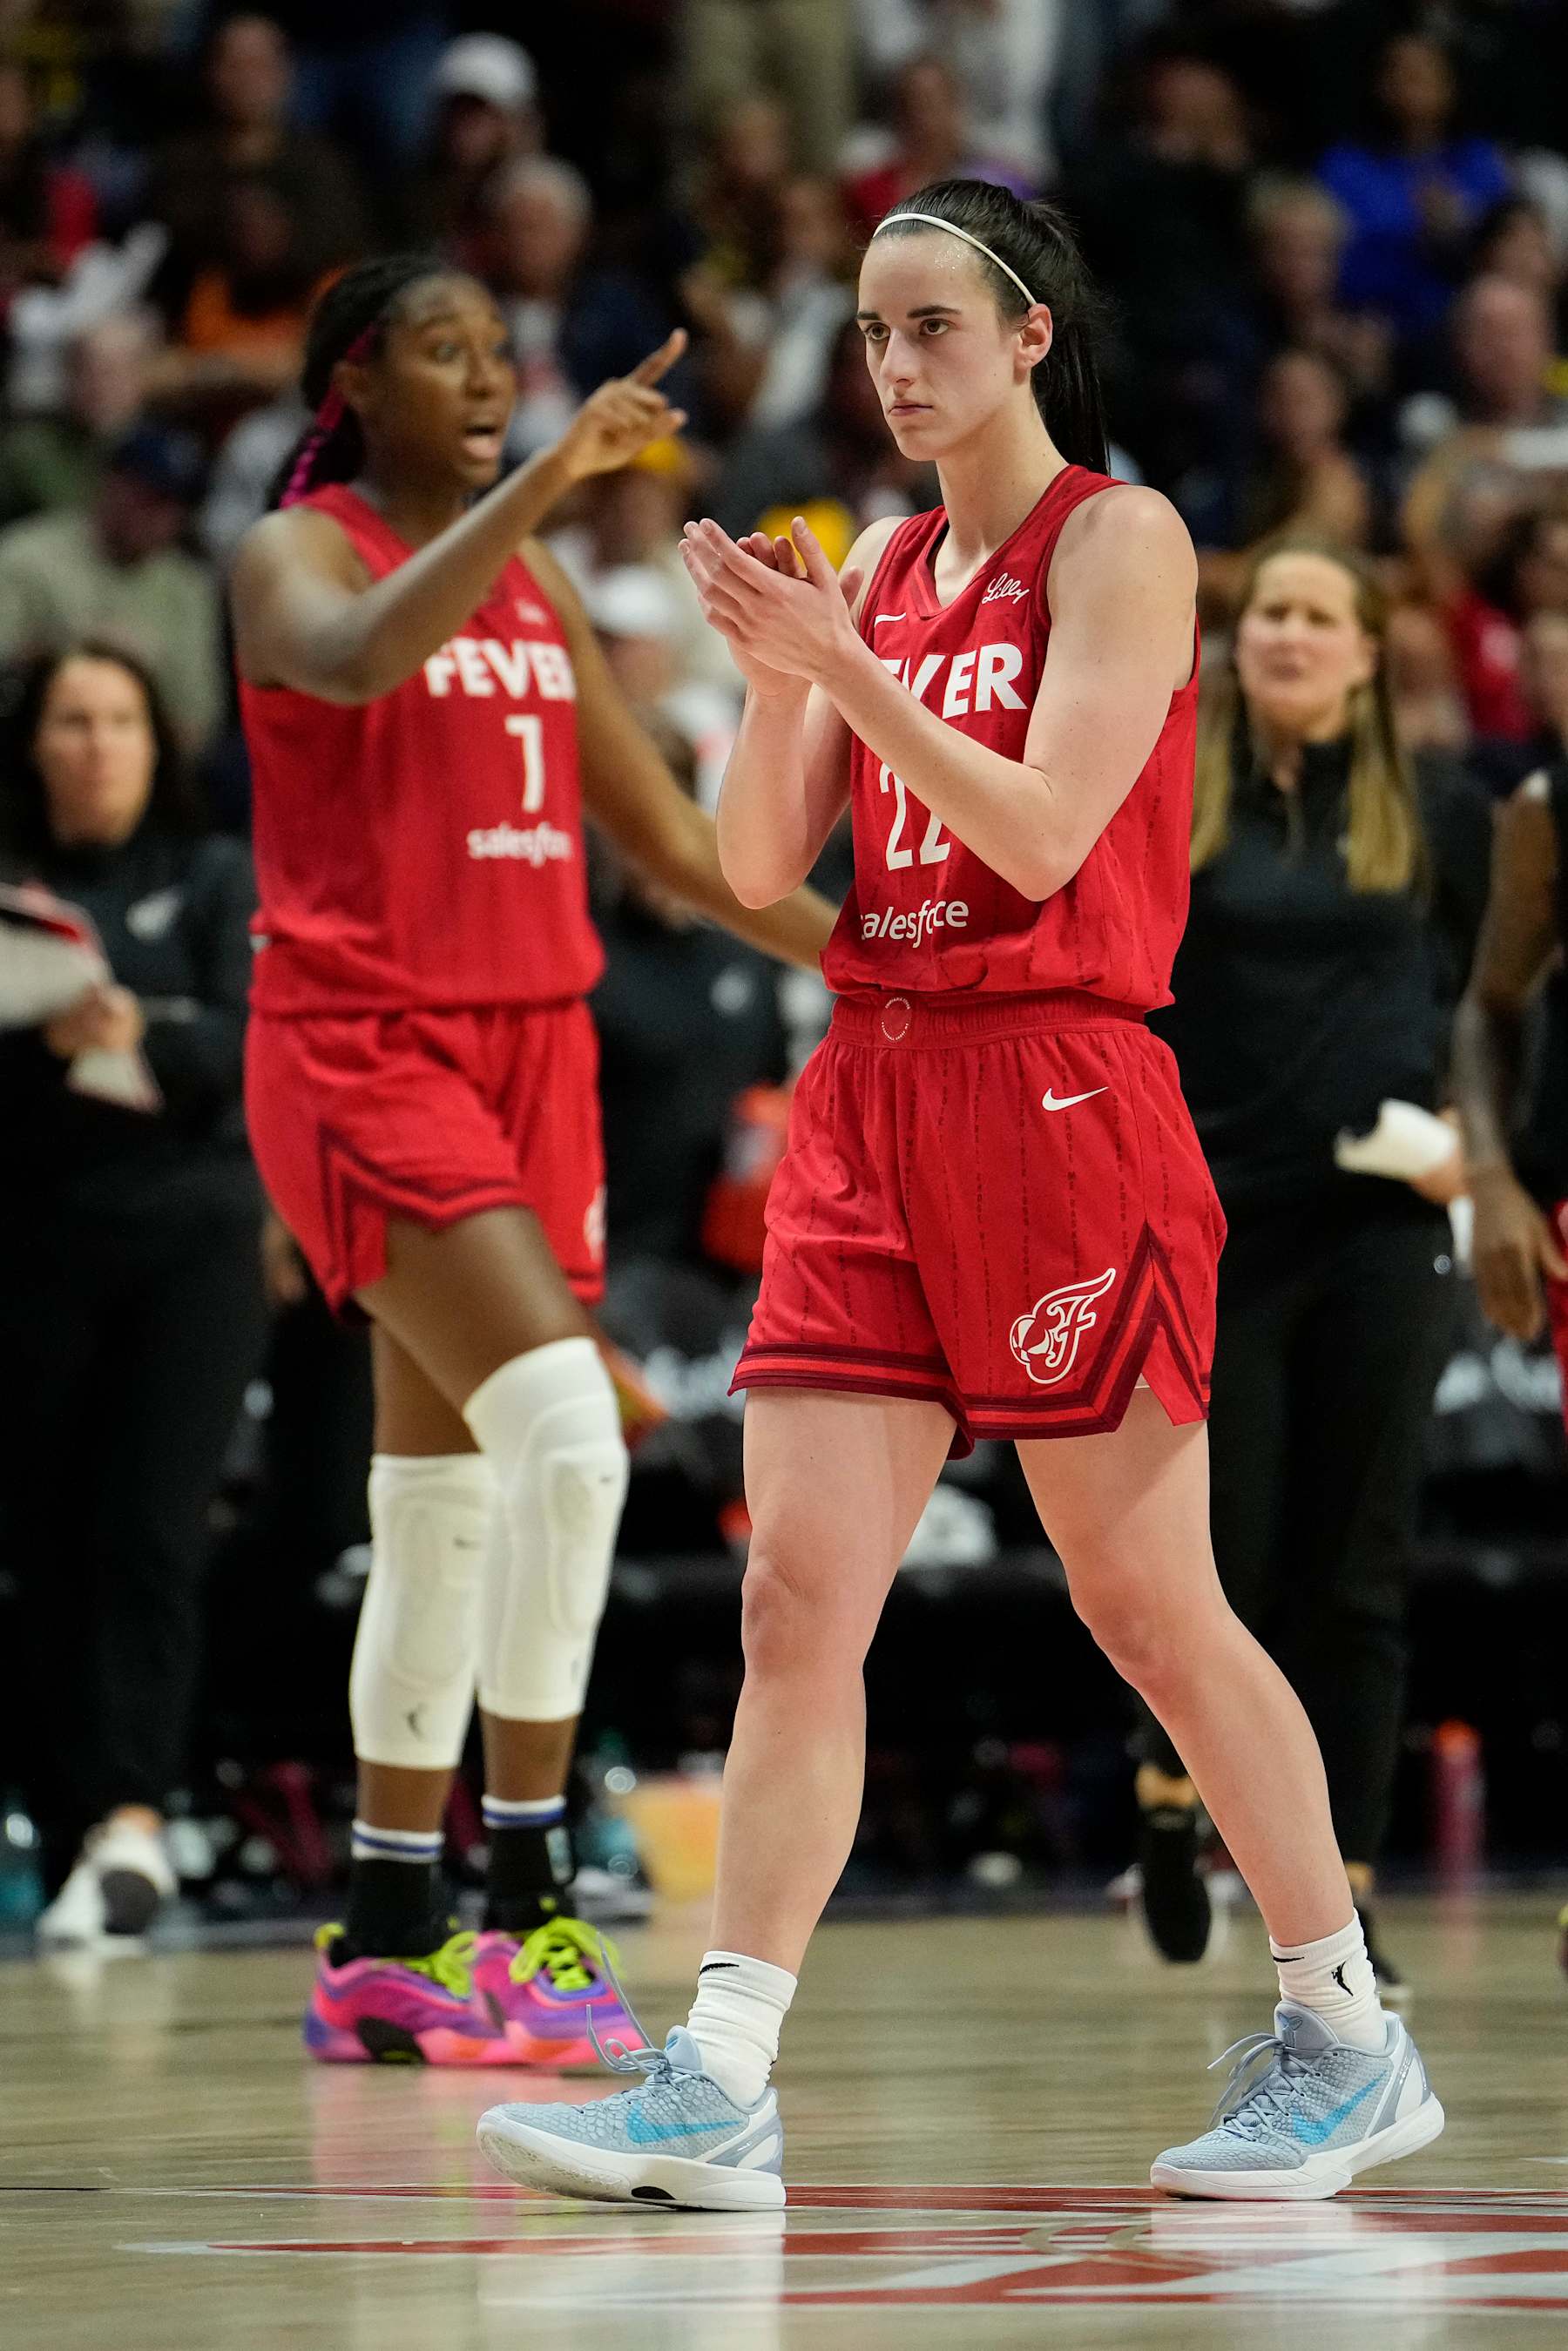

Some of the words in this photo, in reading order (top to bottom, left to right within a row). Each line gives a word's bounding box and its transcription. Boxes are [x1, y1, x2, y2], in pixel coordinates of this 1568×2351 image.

[982, 572, 1030, 605] Lilly
[423, 638, 577, 699] FEVE
[504, 714, 545, 814] 1
